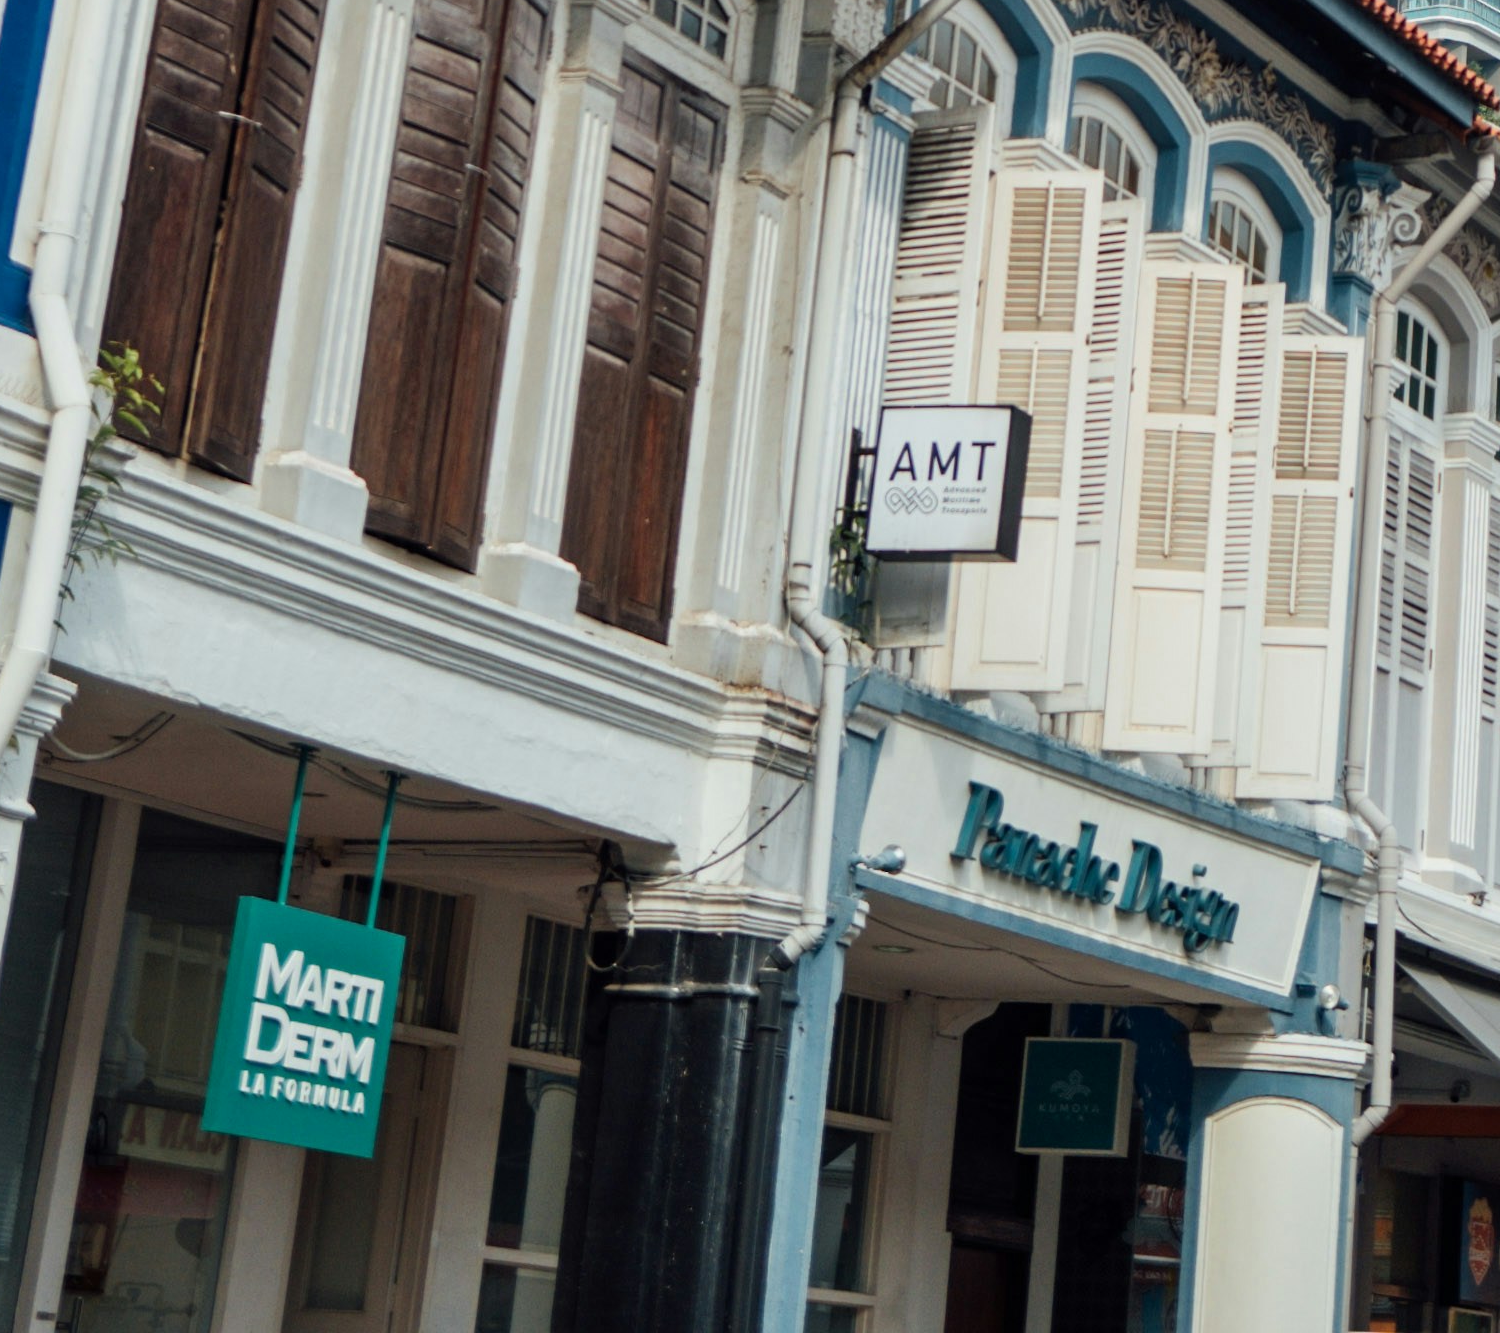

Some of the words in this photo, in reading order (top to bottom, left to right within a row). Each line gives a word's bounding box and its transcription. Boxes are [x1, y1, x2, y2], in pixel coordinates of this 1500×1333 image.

[889, 441, 996, 481] AMT
[950, 781, 1120, 906] Panache
[1115, 839, 1239, 953] Design
[254, 942, 384, 1024] MARTI
[244, 1002, 375, 1084] DERM
[239, 1070, 265, 1096] LA
[270, 1076, 366, 1115] FORMULA
